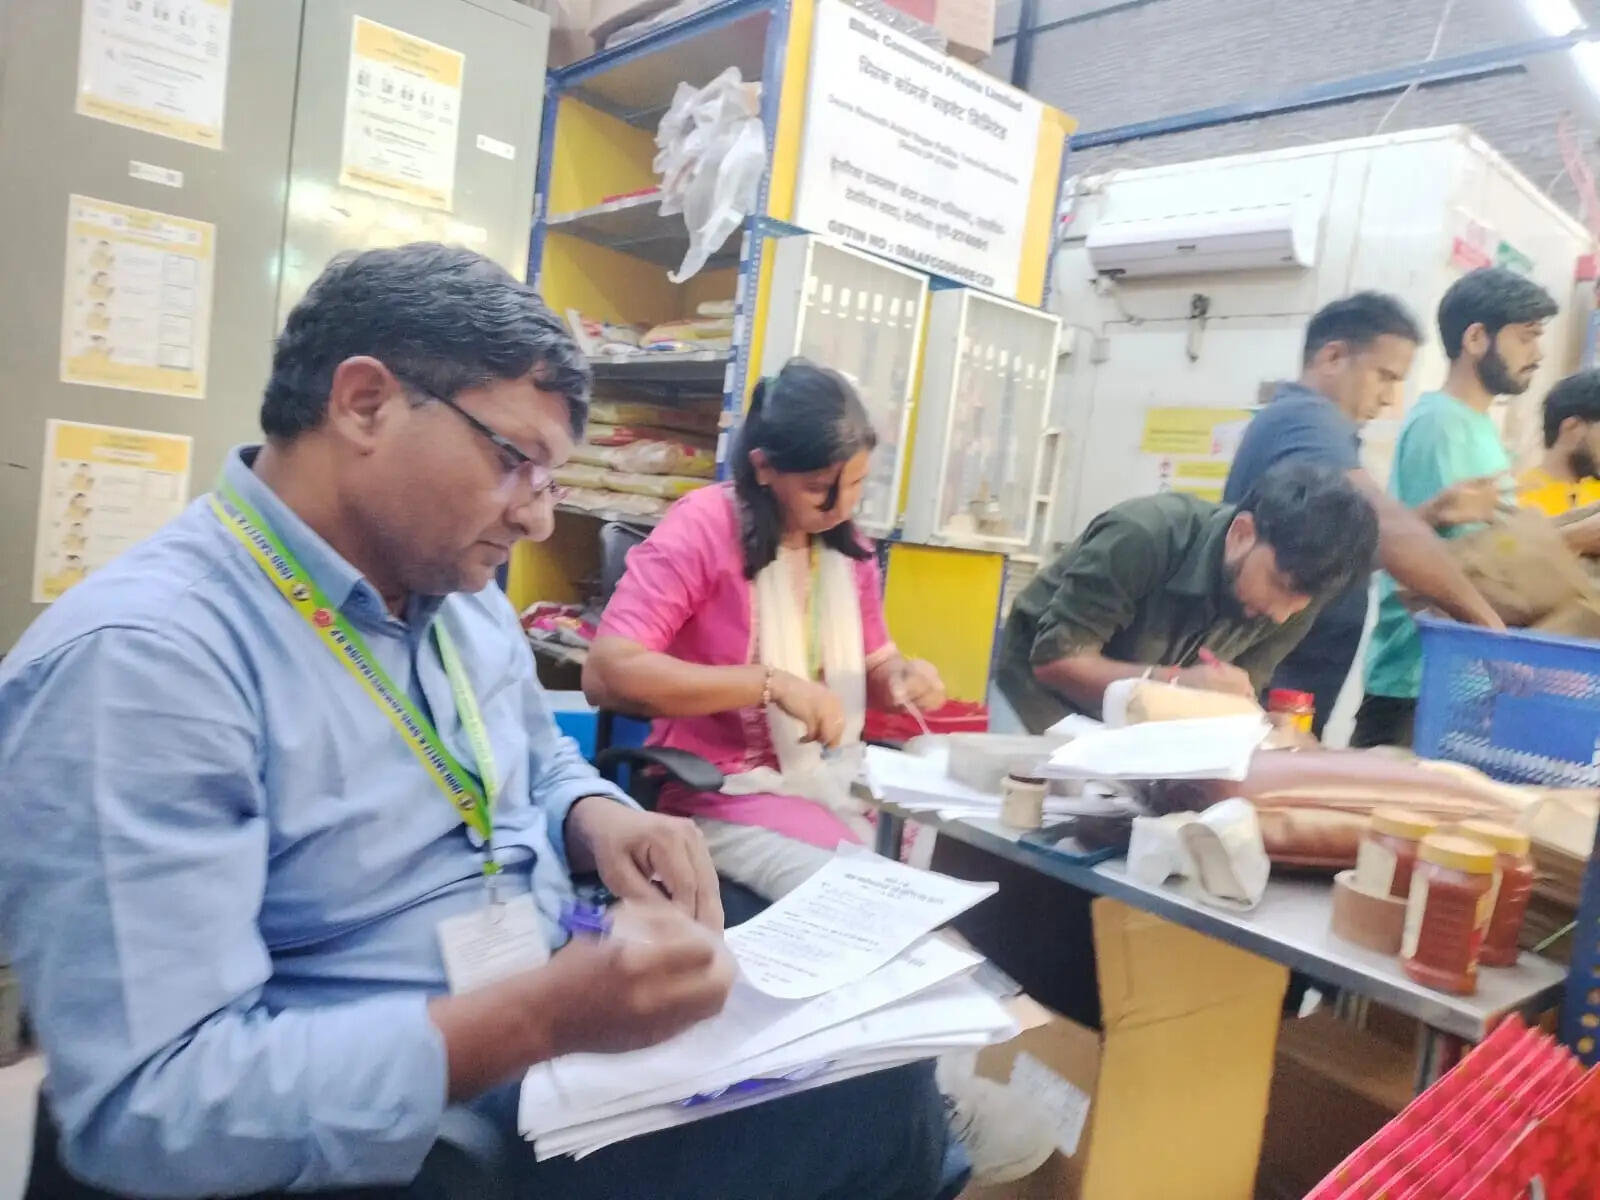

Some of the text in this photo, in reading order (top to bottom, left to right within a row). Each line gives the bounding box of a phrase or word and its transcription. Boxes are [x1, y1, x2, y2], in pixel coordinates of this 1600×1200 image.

[883, 34, 942, 71] Commerce
[945, 65, 982, 92] Private
[985, 85, 1022, 111] Limited
[828, 219, 865, 241] GSTIN
[870, 234, 886, 248] NO
[241, 521, 275, 559] SAFETY
[397, 713, 422, 740] DRUG
[420, 743, 448, 775] SAFETY
[441, 771, 465, 797] FOOD
